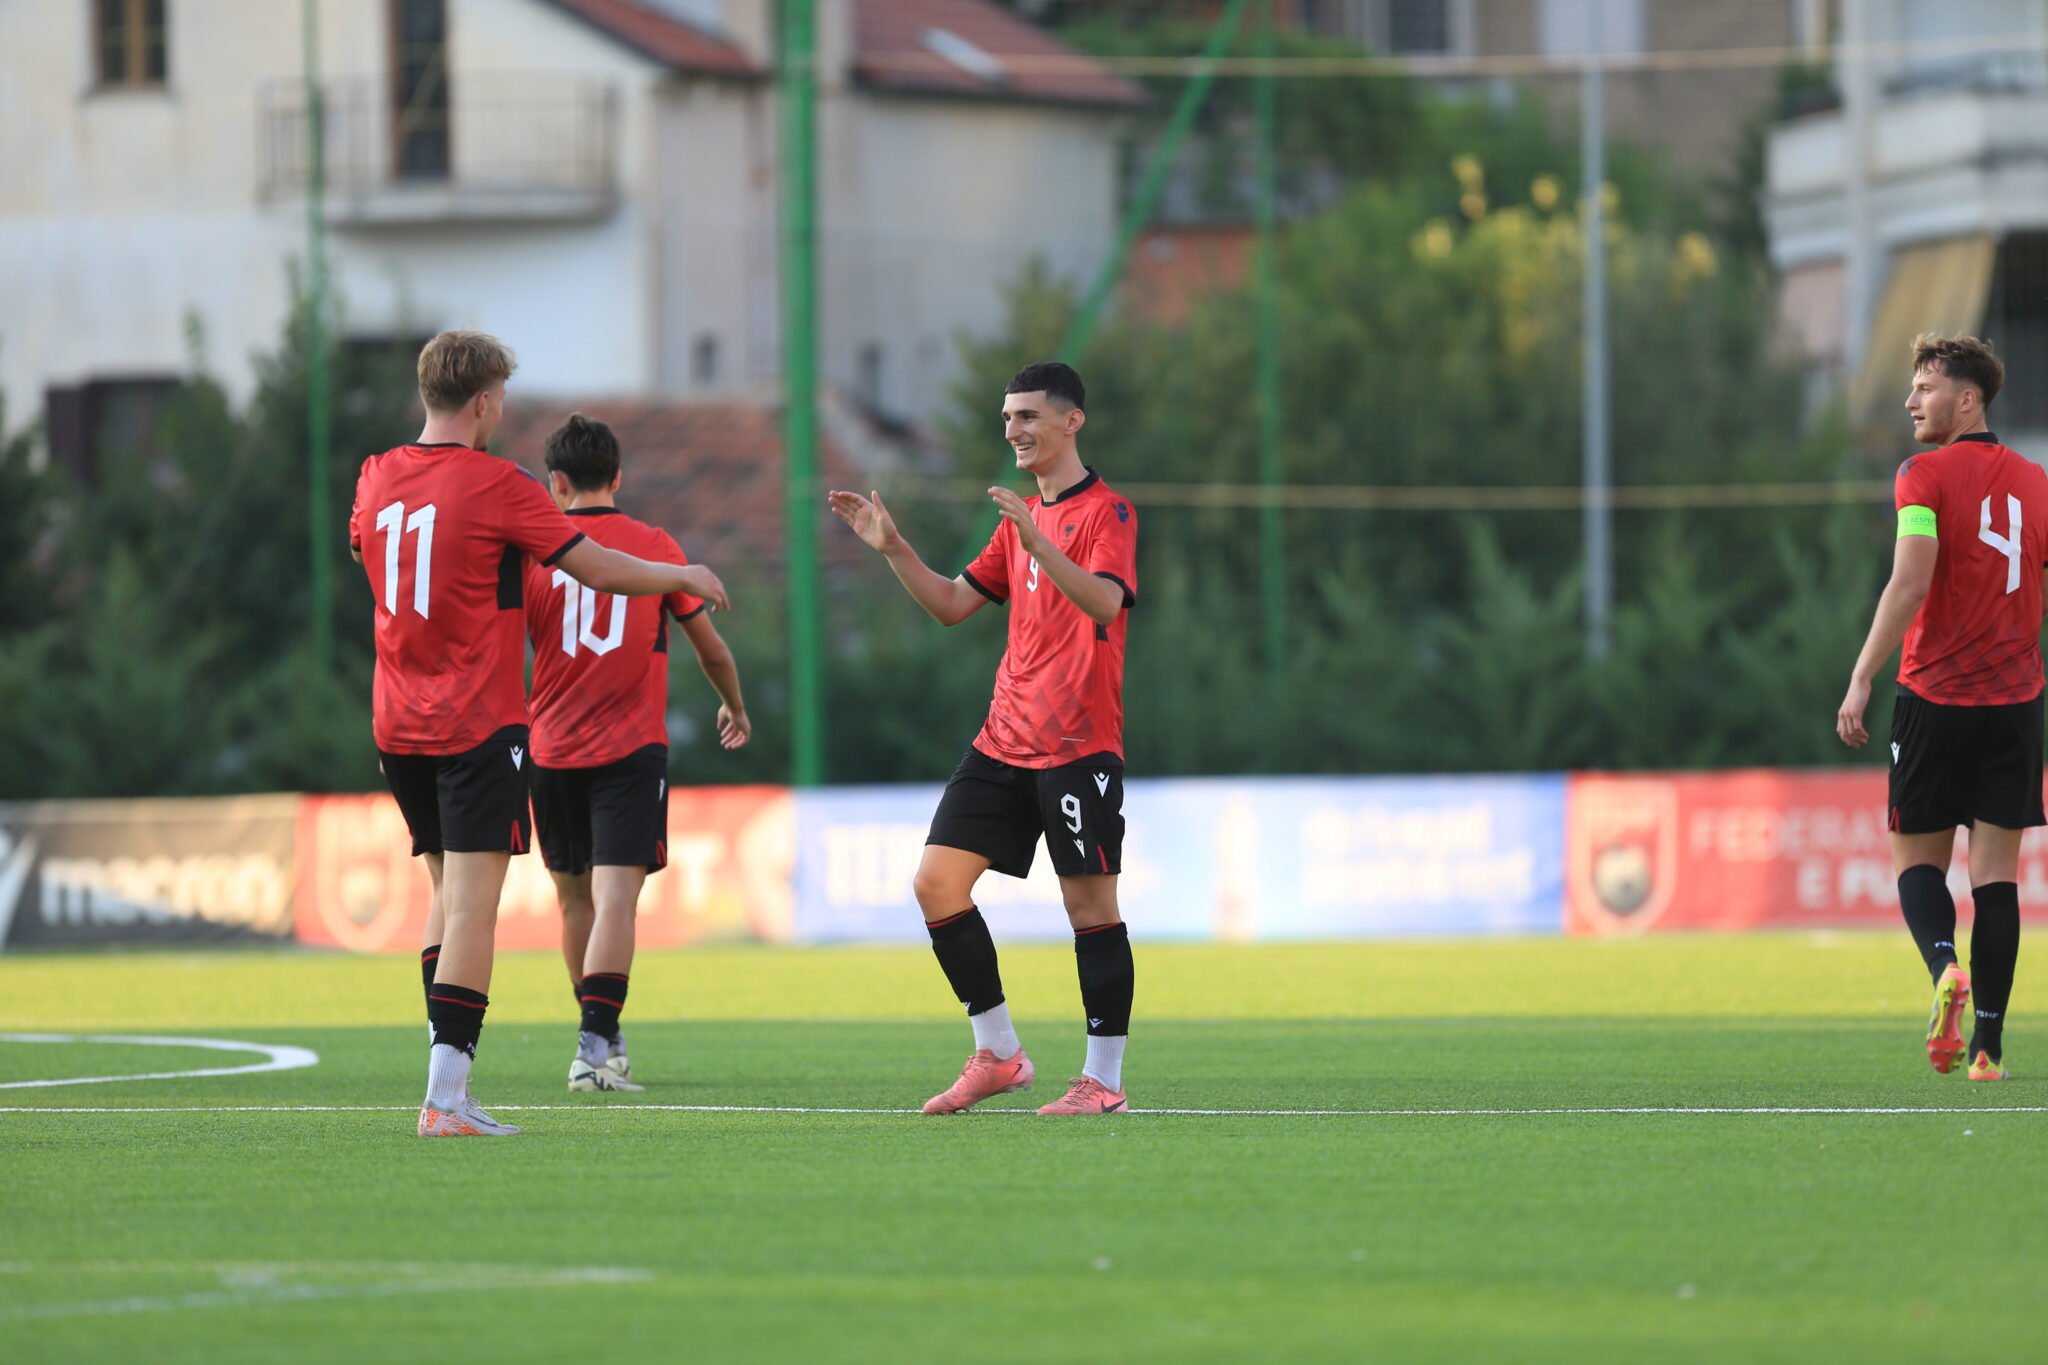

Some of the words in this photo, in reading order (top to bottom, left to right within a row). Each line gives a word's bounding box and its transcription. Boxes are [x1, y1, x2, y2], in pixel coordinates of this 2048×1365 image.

[376, 500, 436, 620] 11
[1978, 493, 2022, 595] 4
[552, 568, 628, 658] 10
[1060, 793, 1082, 834] 9
